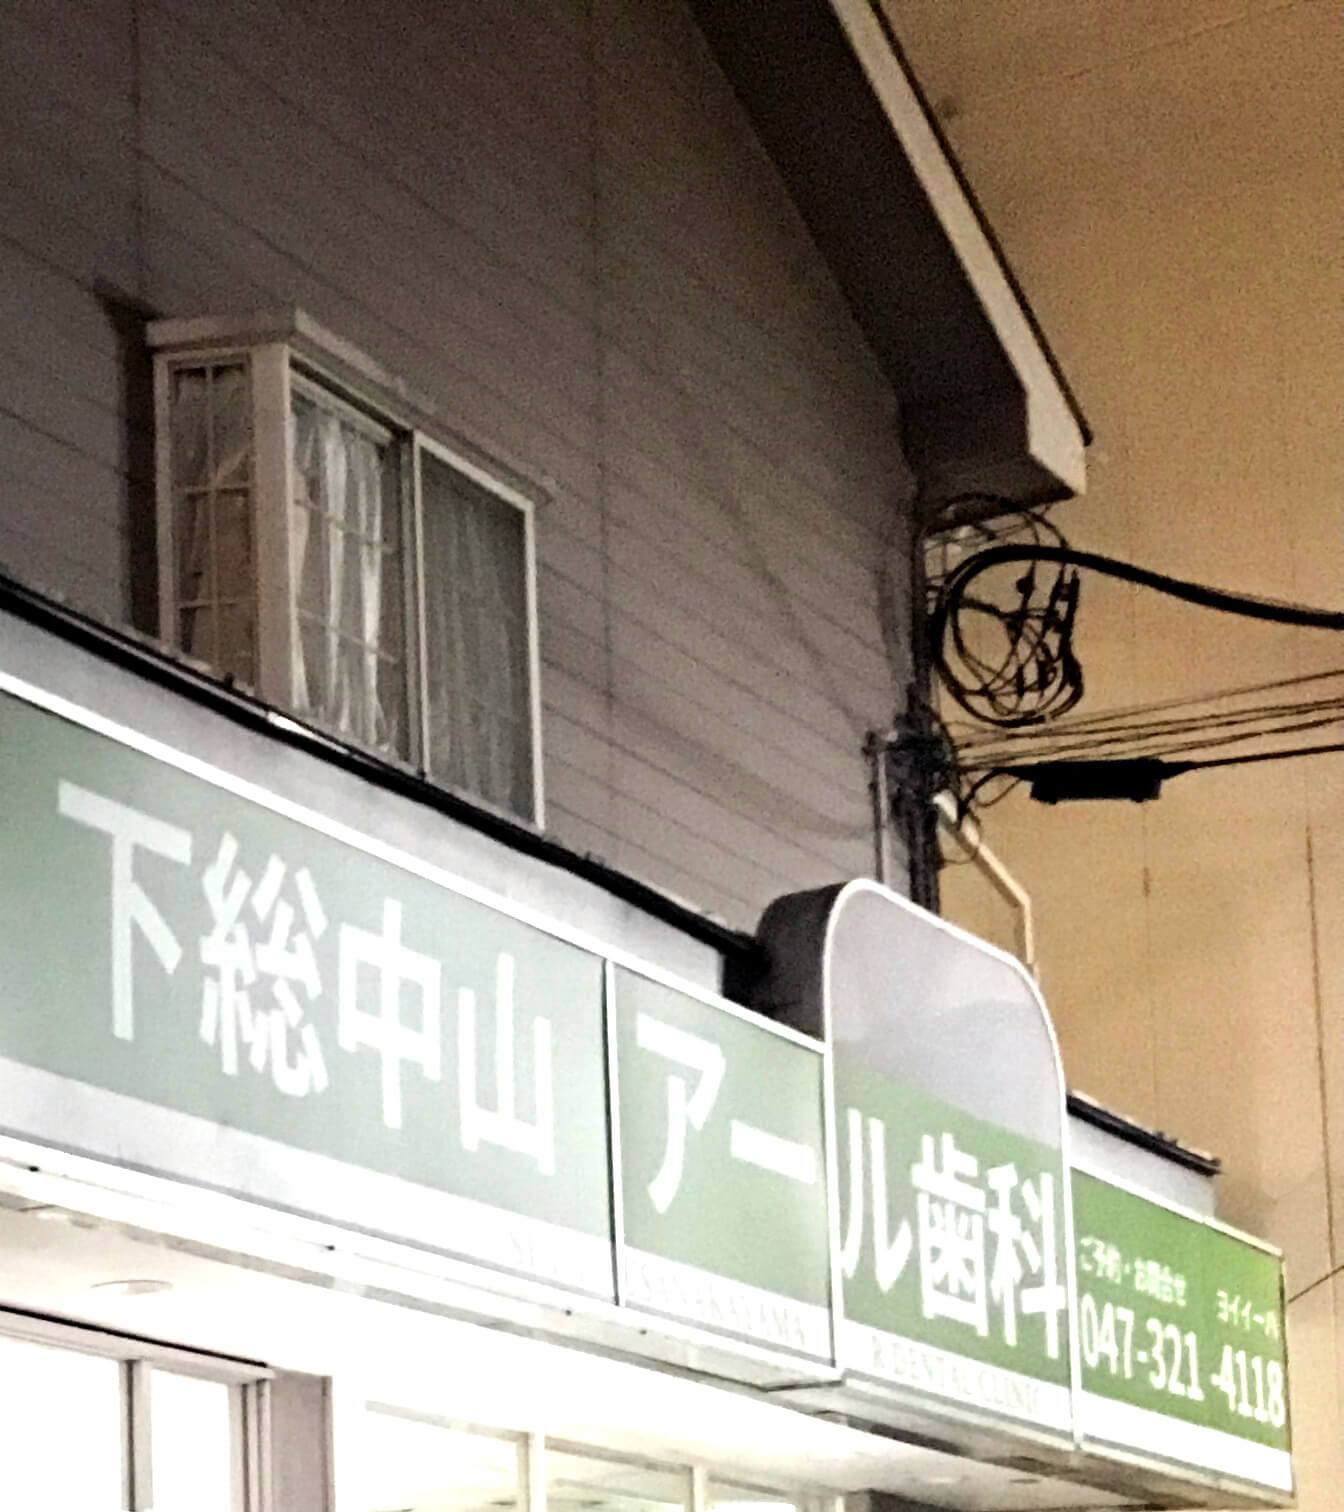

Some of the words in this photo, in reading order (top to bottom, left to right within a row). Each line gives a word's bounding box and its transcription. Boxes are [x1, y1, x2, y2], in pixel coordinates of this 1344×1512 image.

[58, 778, 556, 1177] 下総中山
[635, 1012, 1066, 1360] アール歯科
